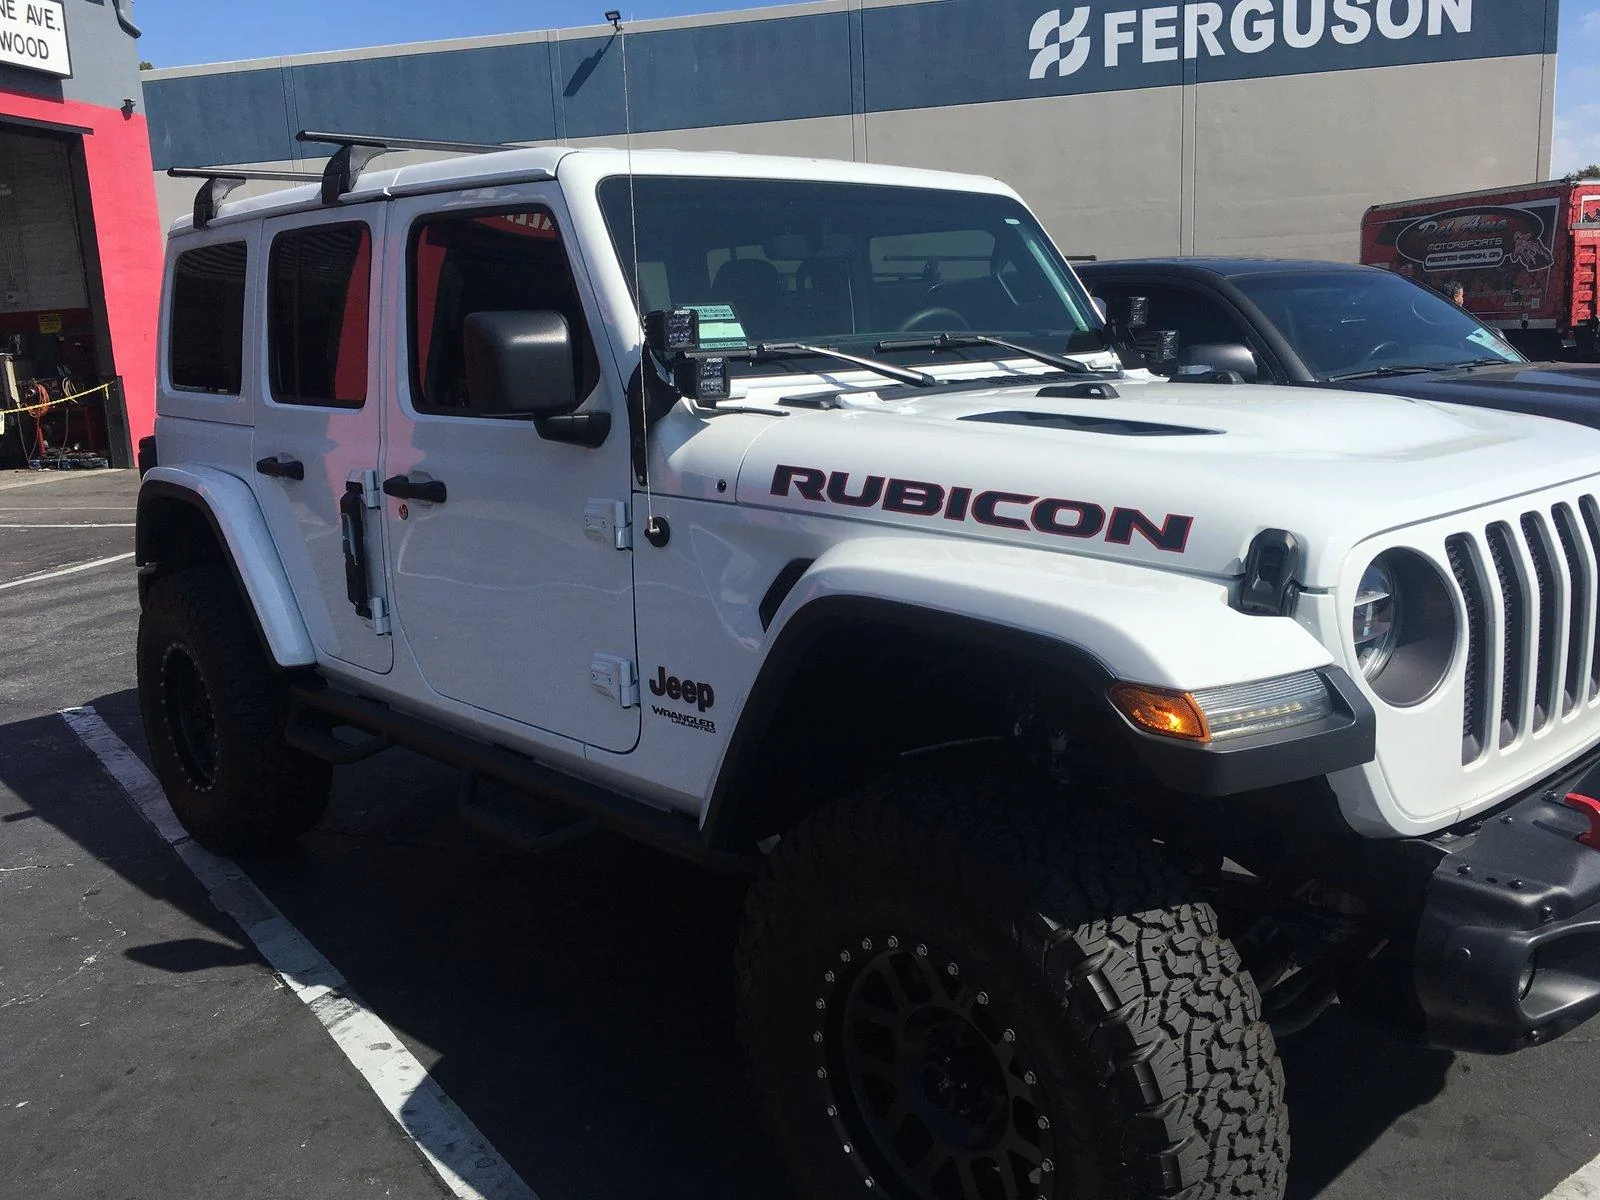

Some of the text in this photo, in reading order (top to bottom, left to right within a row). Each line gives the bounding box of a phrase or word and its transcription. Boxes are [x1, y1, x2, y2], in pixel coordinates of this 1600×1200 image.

[26, 4, 61, 31] AVE.
[1104, 0, 1473, 68] FERGUSON
[1427, 237, 1503, 251] MOTORSPORTS
[770, 464, 1195, 553] RUBICON
[649, 666, 714, 712] Jeep
[652, 705, 715, 730] WRANGLER
[671, 718, 716, 734] UNLIMITED
